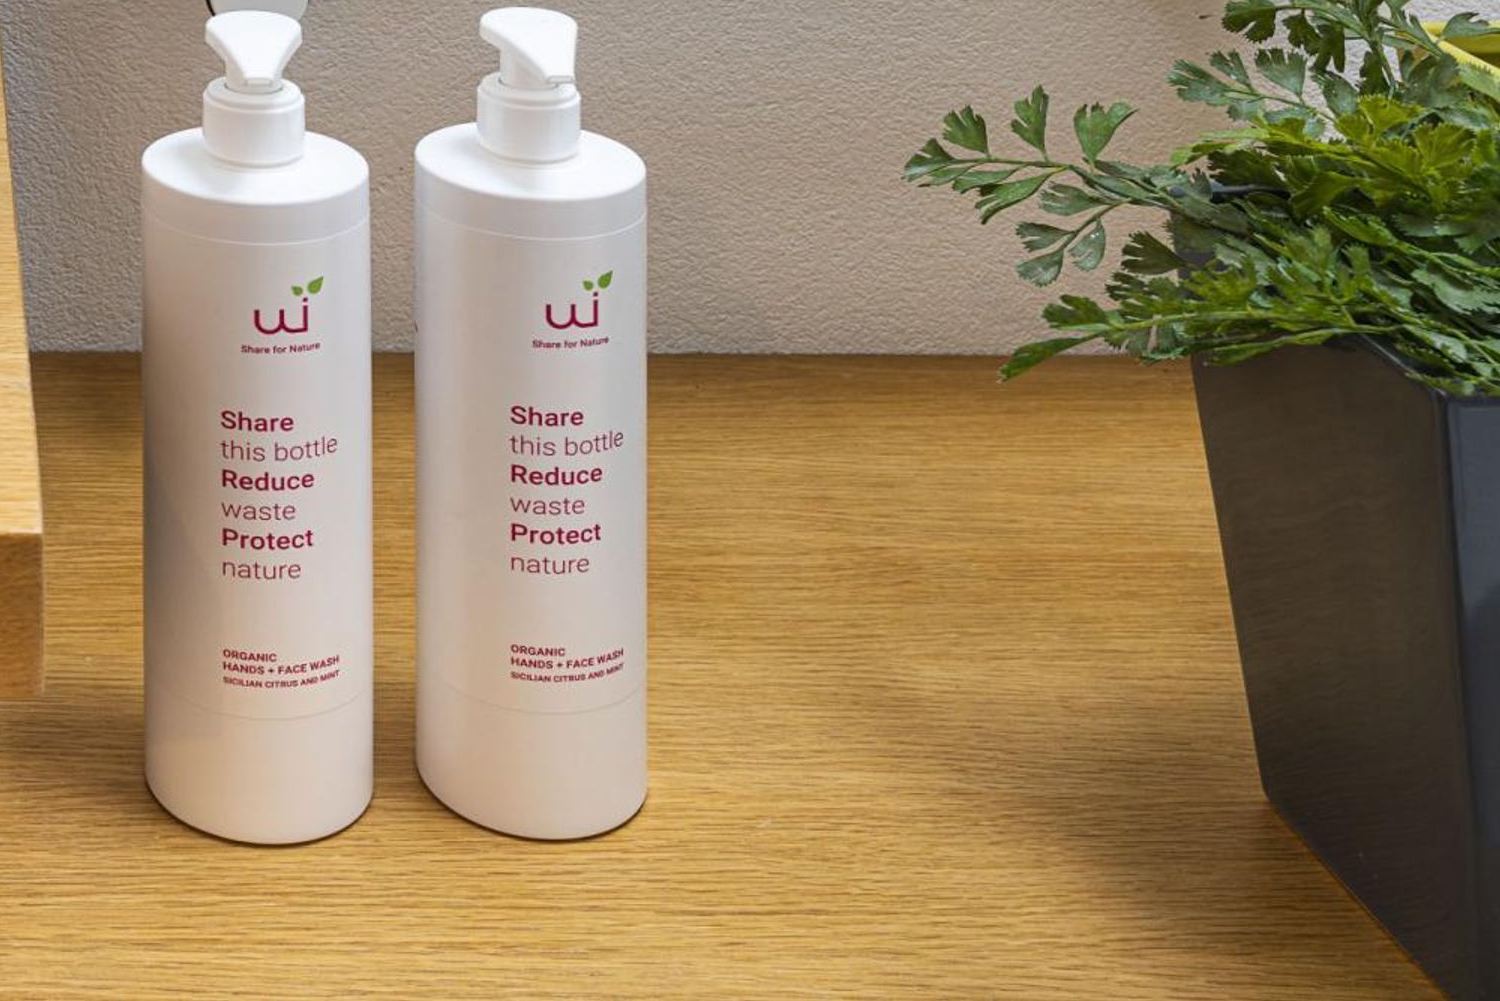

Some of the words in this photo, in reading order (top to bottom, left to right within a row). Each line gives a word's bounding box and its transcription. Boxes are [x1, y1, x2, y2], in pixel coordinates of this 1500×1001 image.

[241, 344, 270, 354] Share
[273, 344, 286, 354] for
[289, 342, 321, 352] Nature
[532, 338, 561, 349] Share
[564, 339, 577, 349] for
[580, 336, 610, 347] Nature
[221, 410, 294, 432] Share
[510, 405, 584, 426] Share
[221, 439, 265, 462] this
[275, 435, 338, 462] bottle
[510, 434, 556, 456] this
[565, 430, 624, 457] bottle
[222, 470, 315, 491] Reduce
[511, 465, 602, 486] Reduce
[222, 501, 296, 521] waste
[510, 496, 585, 515] waste
[222, 528, 314, 551] Protect
[511, 523, 601, 545] Protect
[222, 559, 301, 580] nature
[511, 554, 590, 575] nature
[223, 649, 276, 662] ORGANIC
[511, 644, 565, 656] ORGANIC
[511, 657, 553, 669] HANDS
[567, 658, 594, 668] FACE
[597, 648, 624, 664] WASH
[223, 662, 265, 674] HANDS
[278, 664, 307, 674] FACE
[310, 655, 339, 670] WASH
[511, 672, 551, 682] SICILIAN
[554, 674, 586, 682] CITRUS
[588, 671, 604, 679] AND
[606, 662, 624, 674] MINT
[223, 676, 262, 687] SICILIAN
[301, 678, 318, 686] AND
[320, 670, 340, 681] MINT
